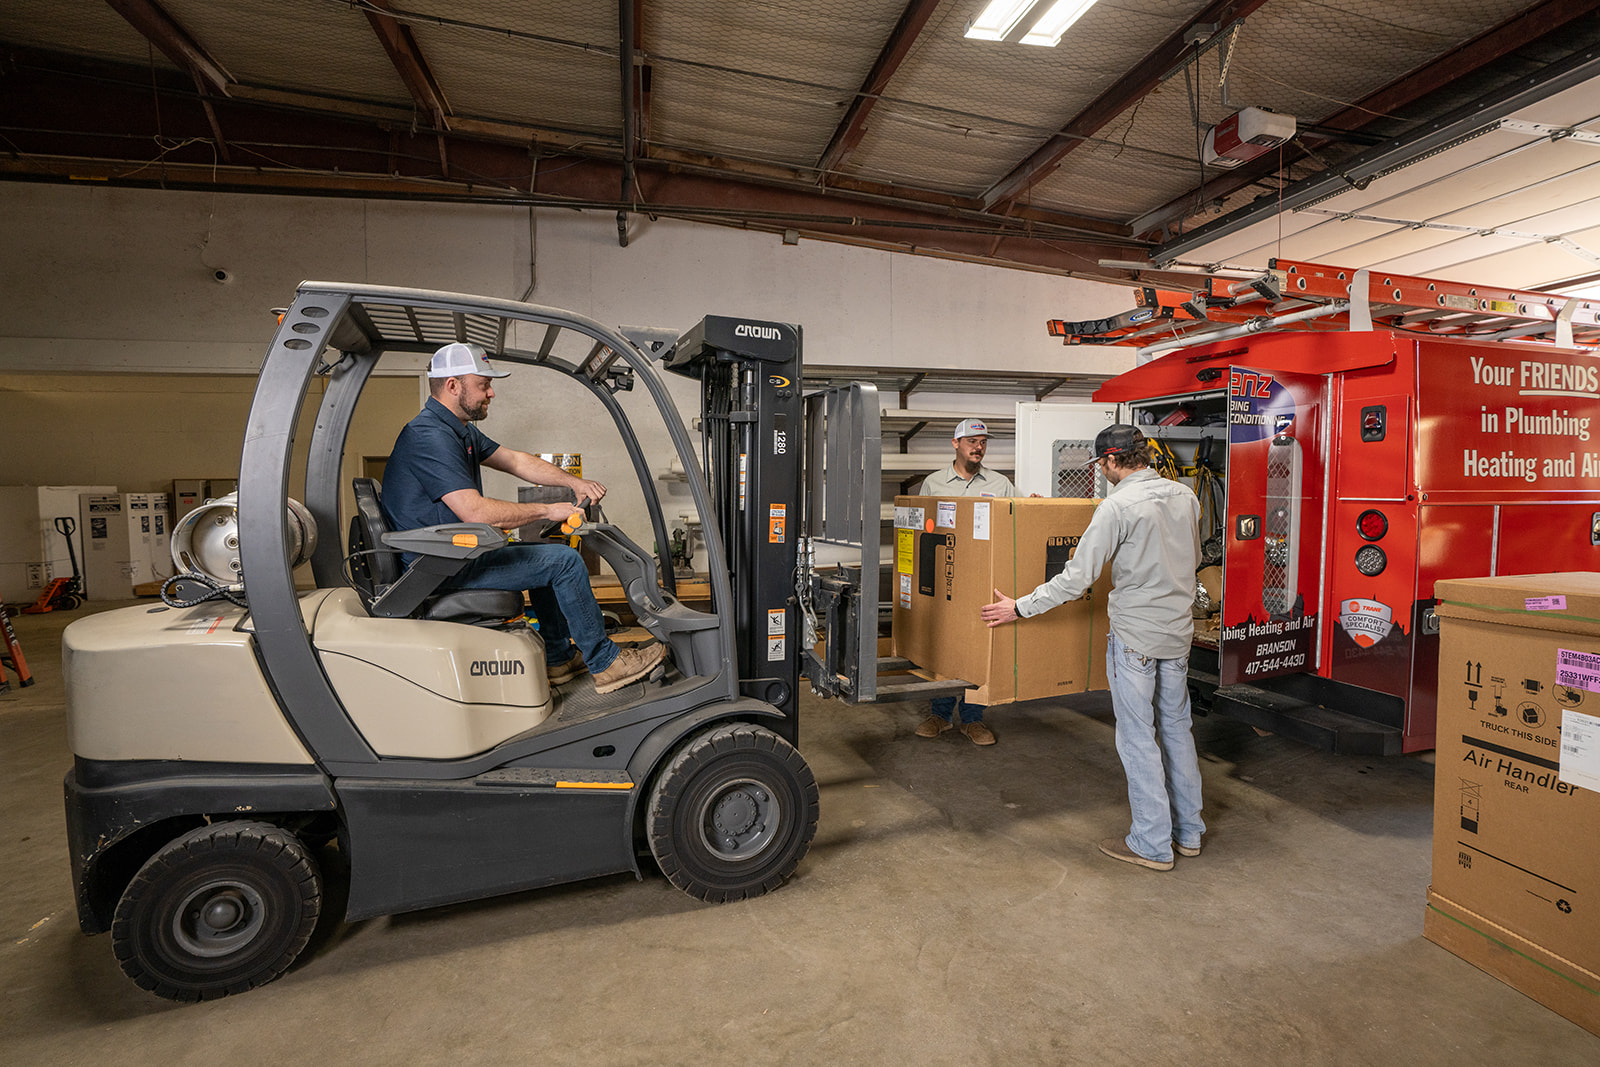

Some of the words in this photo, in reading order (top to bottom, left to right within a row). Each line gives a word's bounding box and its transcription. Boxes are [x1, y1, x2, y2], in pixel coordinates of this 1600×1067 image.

[735, 325, 781, 340] CROWN
[1470, 356, 1515, 387] Your
[1520, 360, 1599, 393] FRIENDS
[1481, 405, 1499, 433] in
[1505, 406, 1591, 441] Plumbing
[777, 430, 787, 454] 1280
[1463, 449, 1538, 482] Heating
[1542, 452, 1575, 478] and
[1580, 452, 1600, 478] Ai
[1362, 605, 1382, 613] TRANE
[1248, 620, 1284, 637] Heating
[1284, 616, 1301, 632] and
[1302, 614, 1316, 629] Air
[1345, 621, 1386, 634] SPECIALIST
[1347, 615, 1384, 627] COMFORT
[1255, 638, 1297, 657] BRANSON
[470, 660, 525, 677] CROWN
[1244, 653, 1306, 676] 417-544-4430
[1560, 669, 1600, 685] 25331WFF
[1480, 719, 1509, 735] TRUCK
[1511, 728, 1533, 742] THIS
[1534, 734, 1558, 748] SIDE
[1463, 749, 1493, 769] Air
[1496, 758, 1580, 797] Handler
[1504, 779, 1530, 794] REAR
